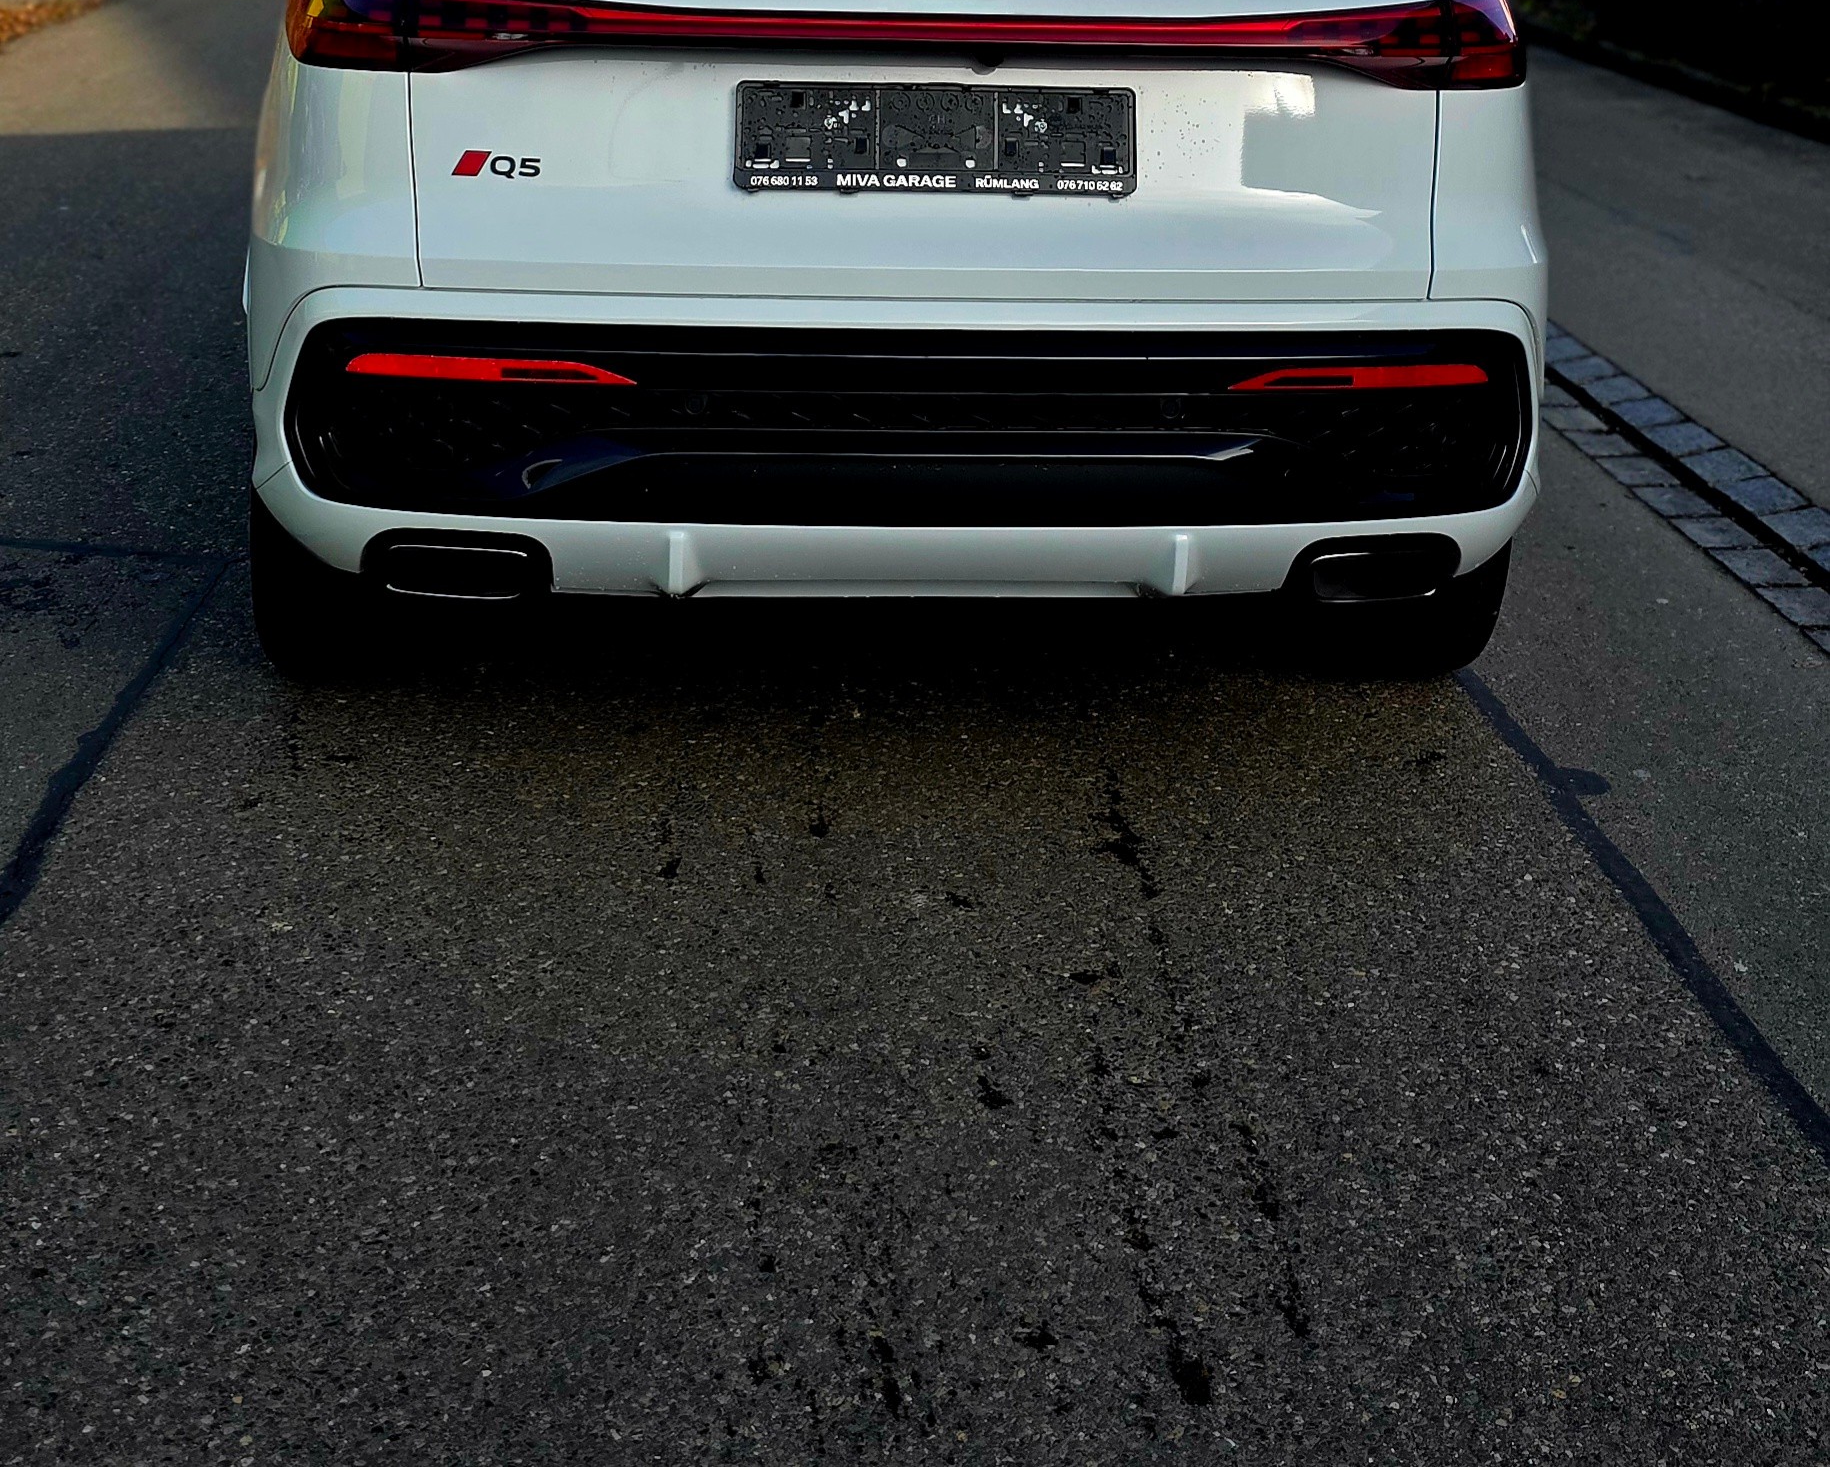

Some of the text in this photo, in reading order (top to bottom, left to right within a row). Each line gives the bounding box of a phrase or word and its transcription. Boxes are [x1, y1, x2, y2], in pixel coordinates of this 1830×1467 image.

[490, 155, 541, 179] Q5
[750, 175, 769, 186] 076
[770, 175, 789, 186] 680
[791, 175, 803, 186] 11
[805, 175, 818, 186] 53
[836, 174, 880, 187] MIVA
[883, 174, 957, 188] GARAGE
[1077, 180, 1095, 191] 710
